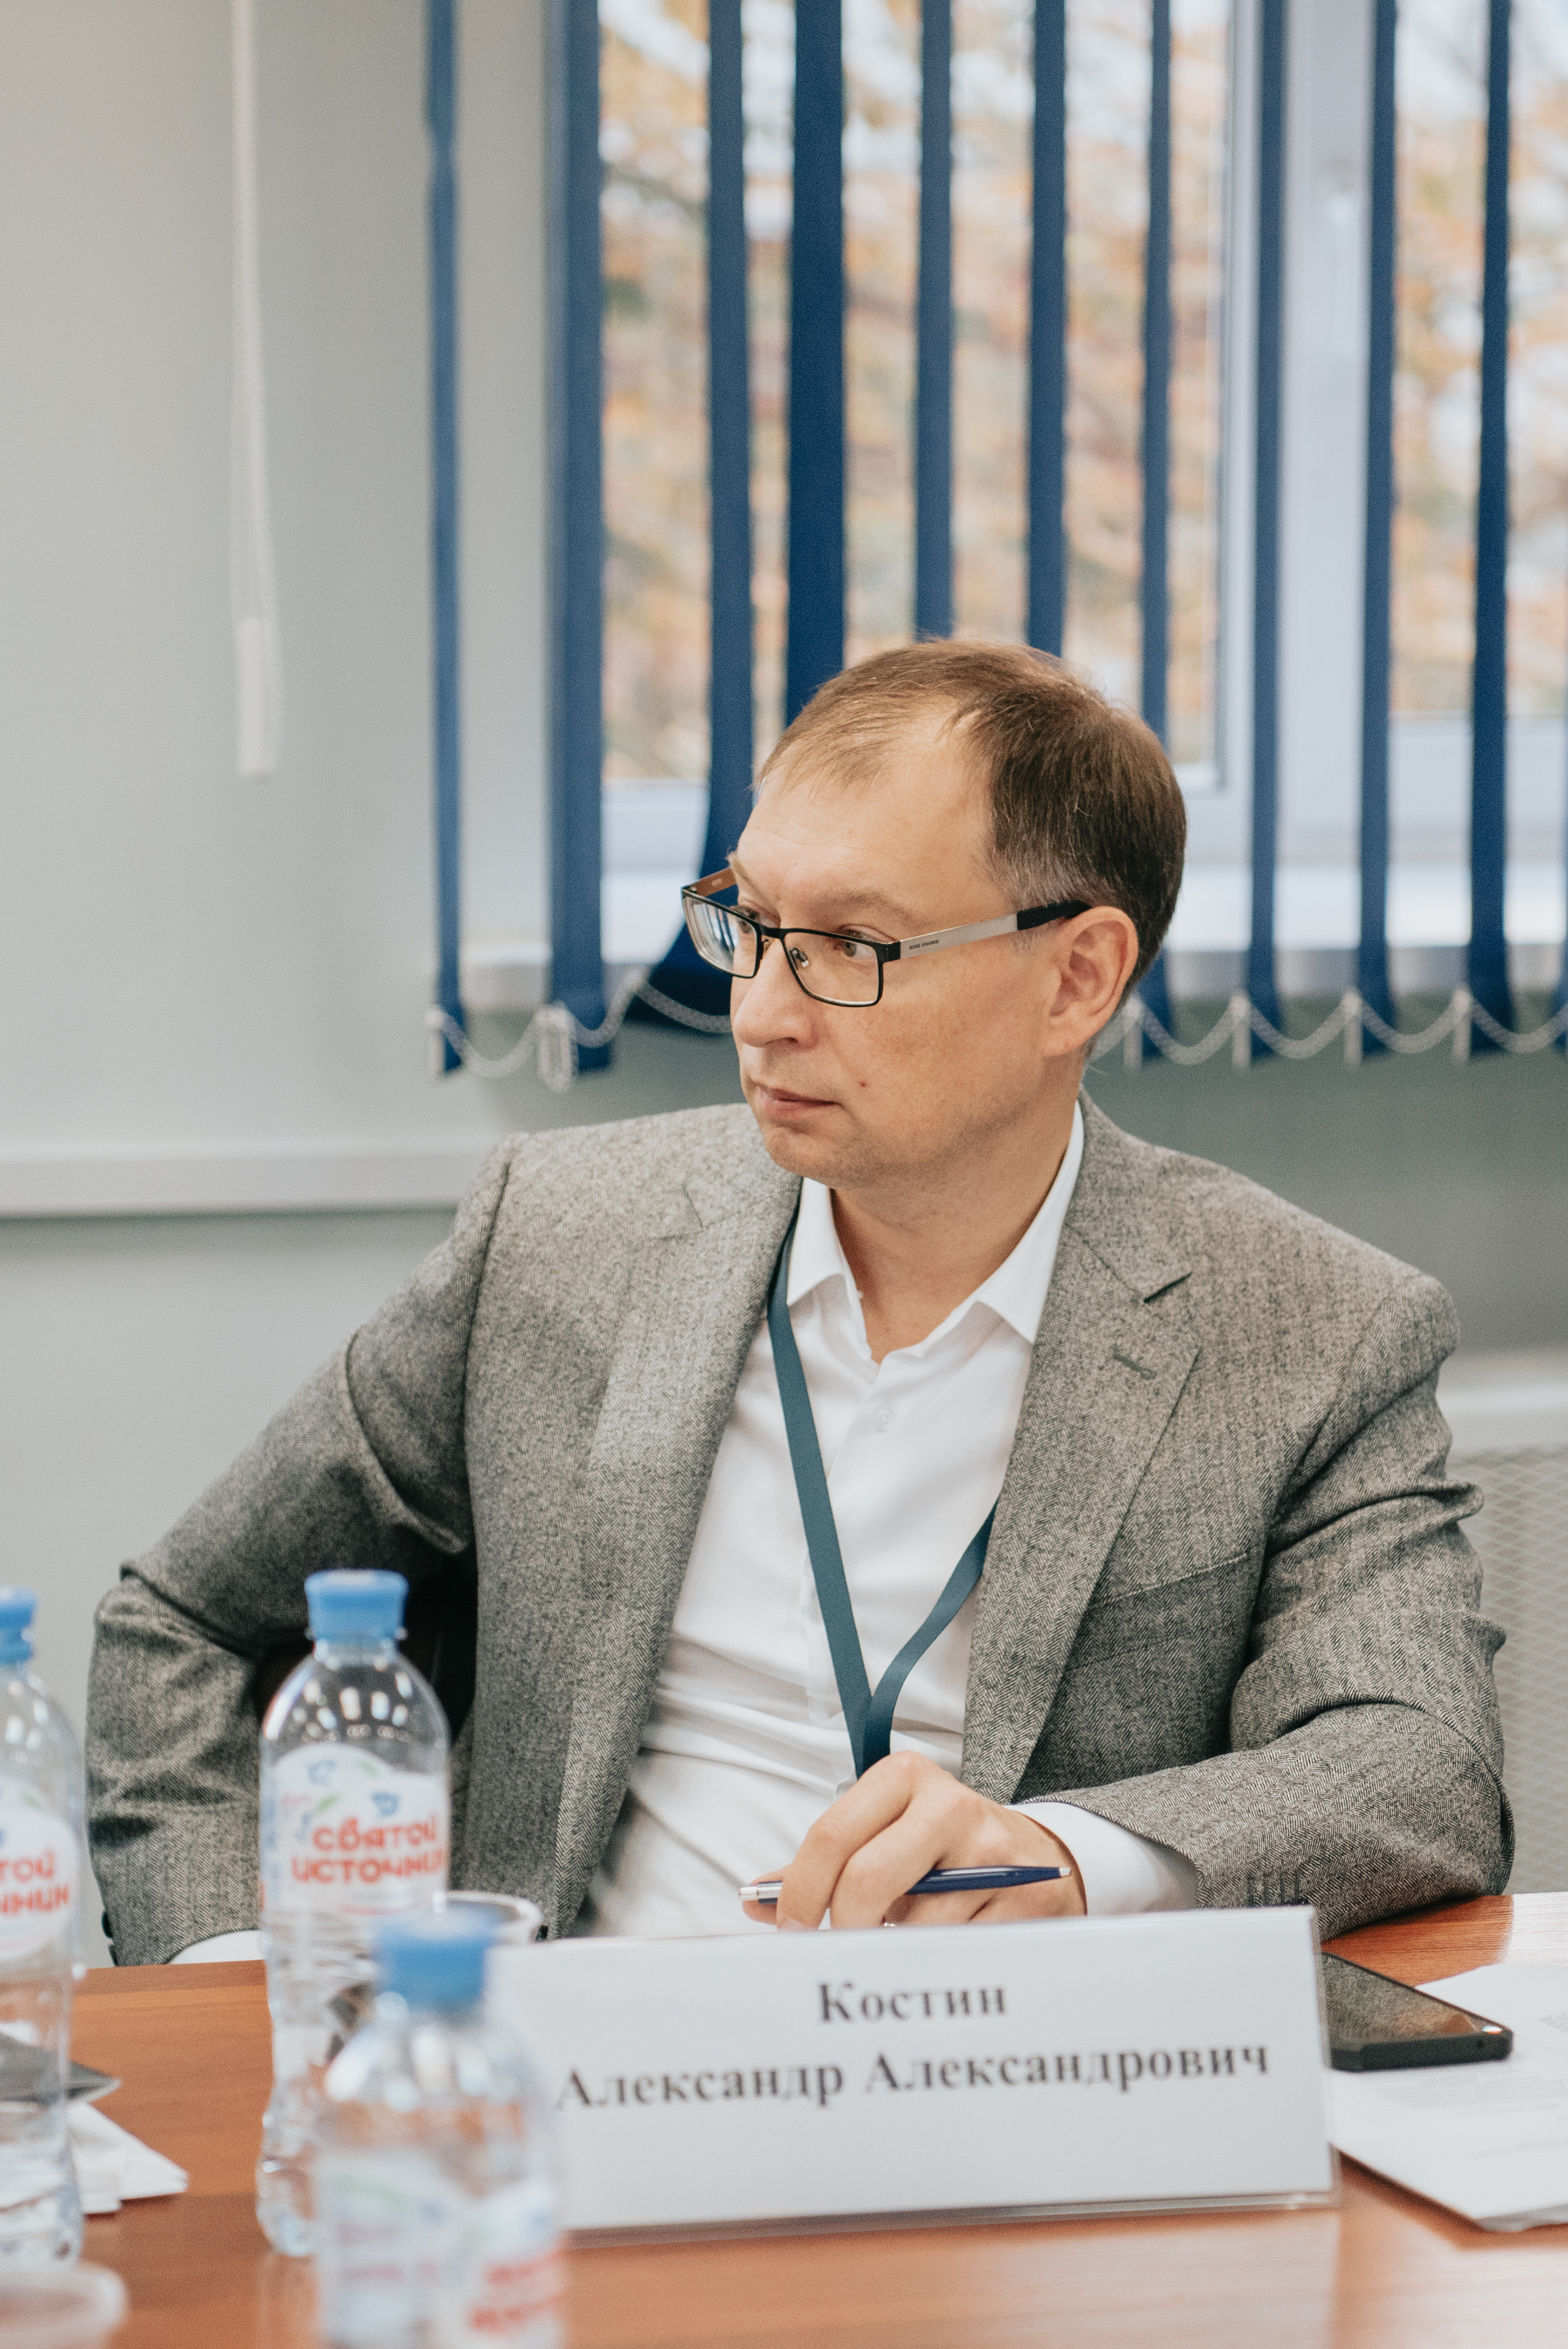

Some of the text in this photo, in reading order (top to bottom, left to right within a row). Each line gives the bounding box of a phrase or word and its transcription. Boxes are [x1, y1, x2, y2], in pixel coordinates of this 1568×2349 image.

[816, 1980, 1008, 2023] Костин
[556, 2045, 1270, 2109] Александр Александрович
